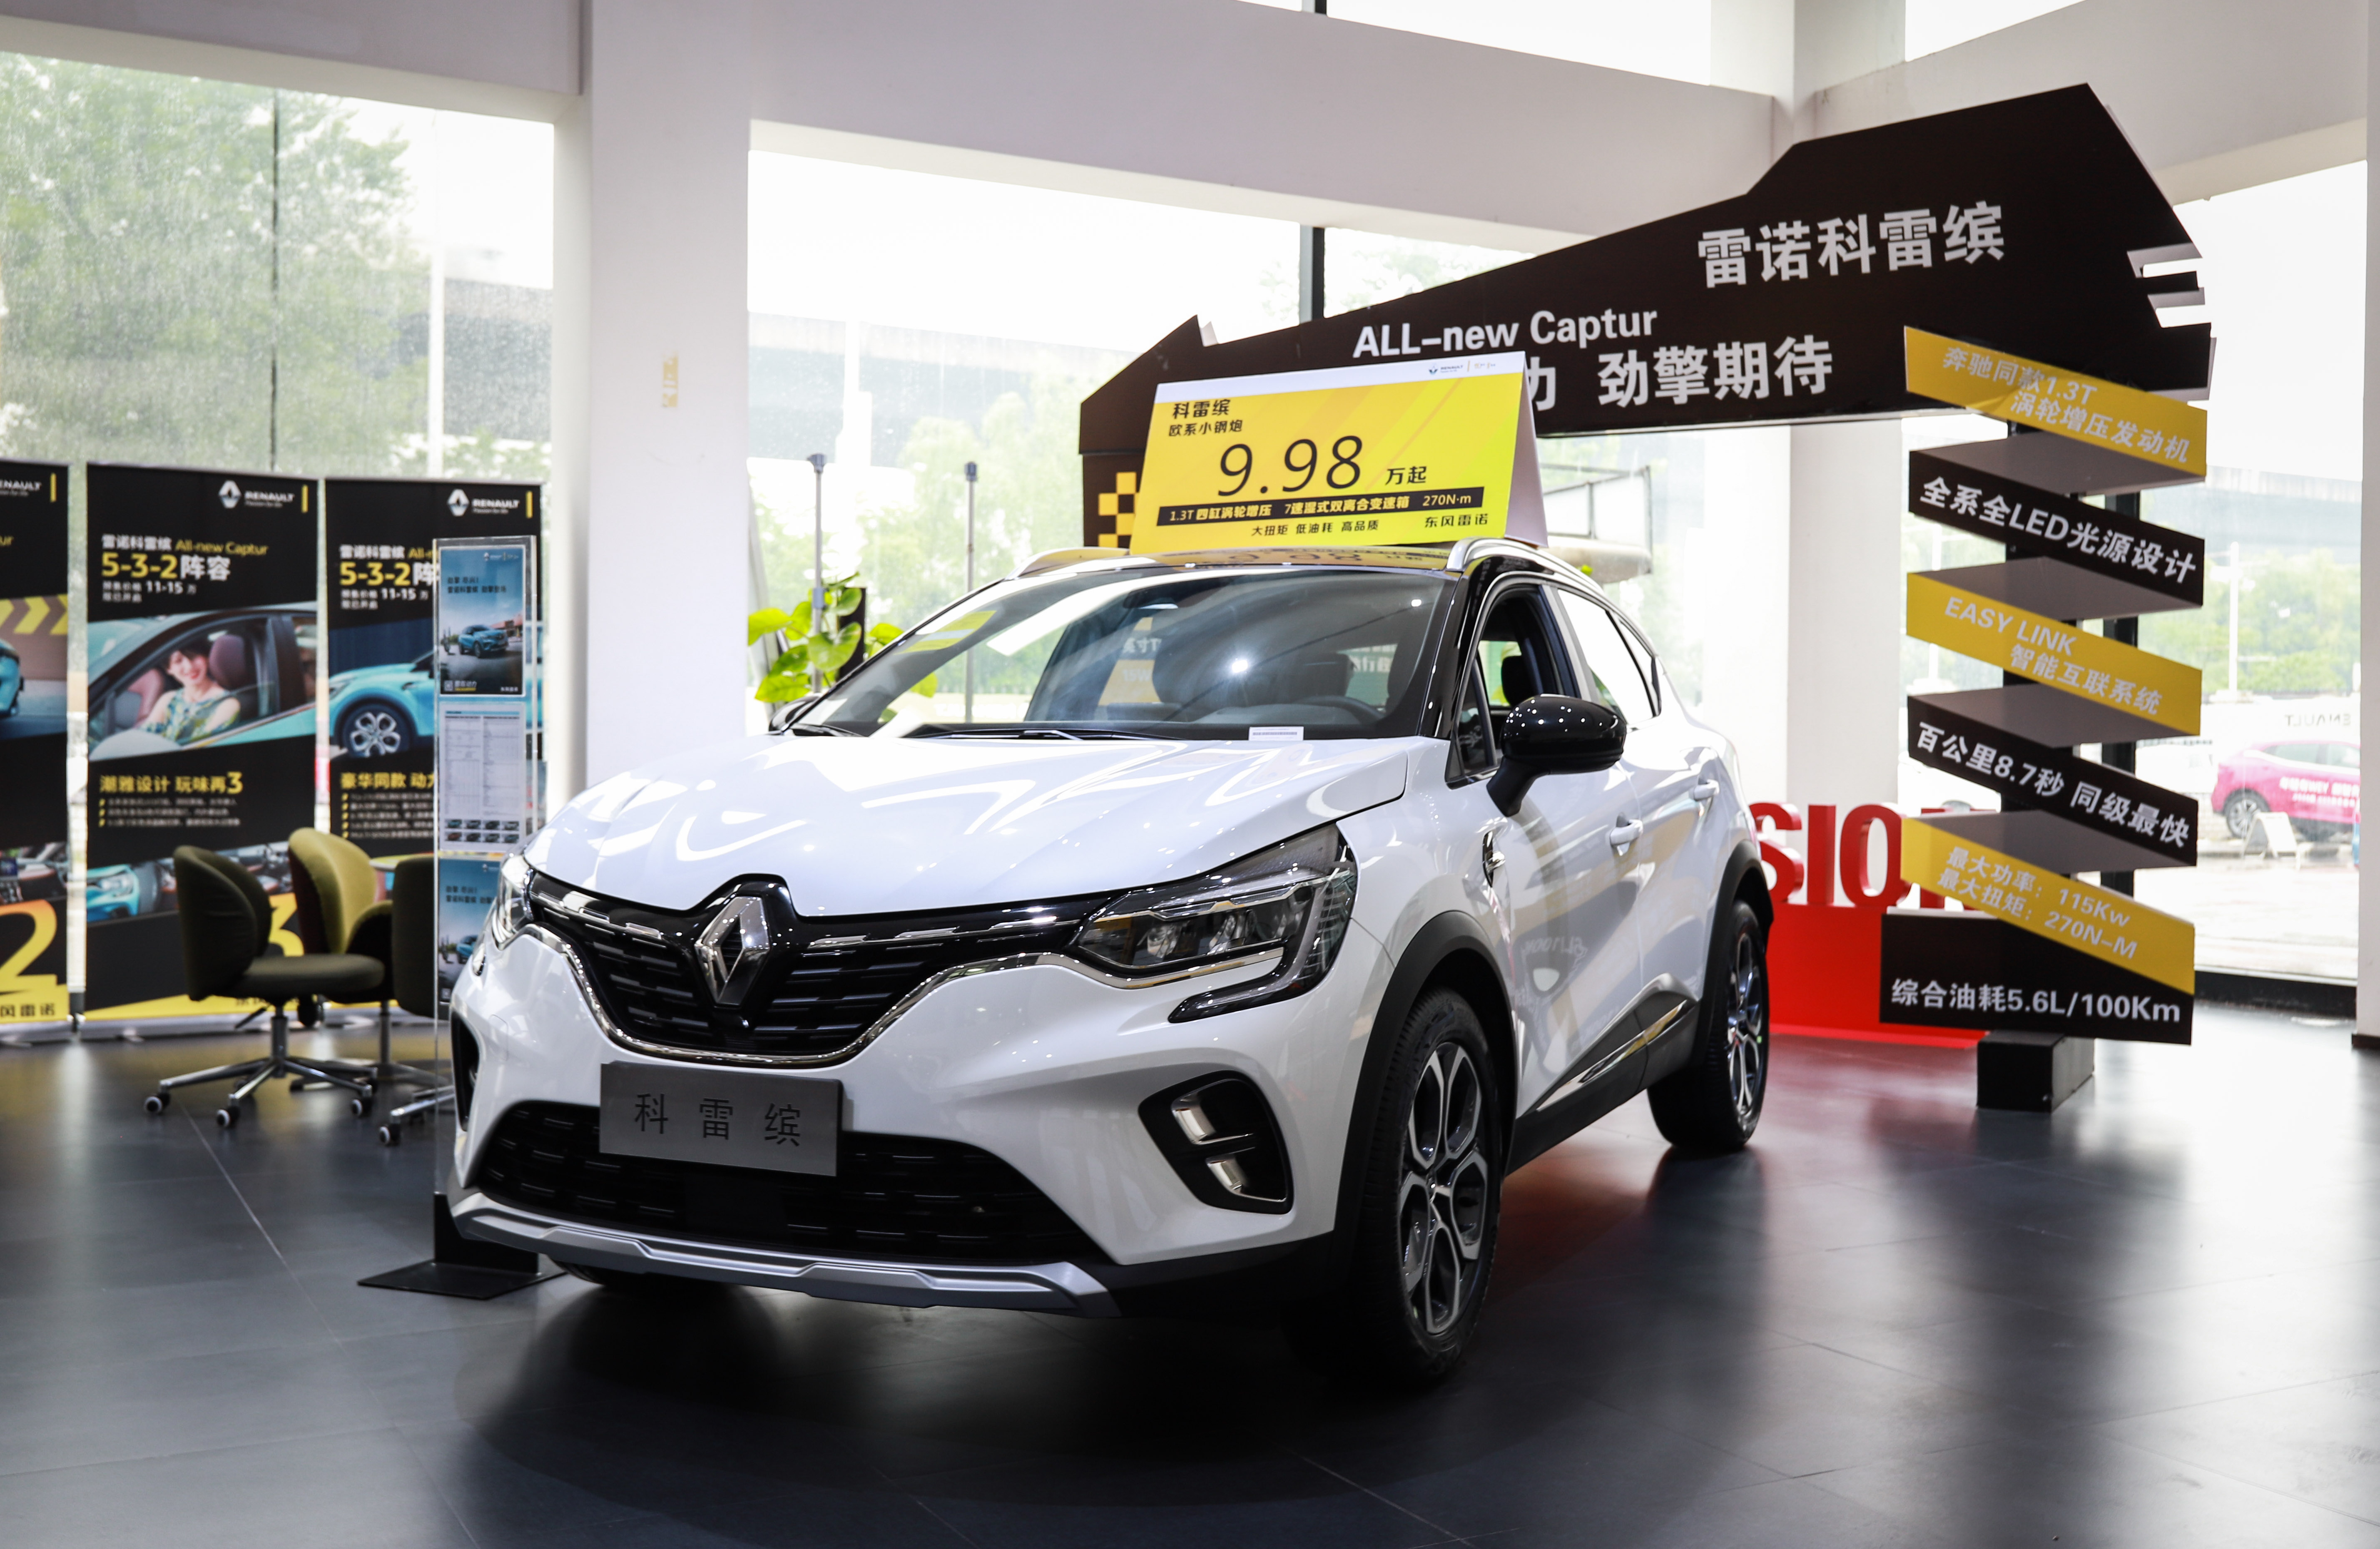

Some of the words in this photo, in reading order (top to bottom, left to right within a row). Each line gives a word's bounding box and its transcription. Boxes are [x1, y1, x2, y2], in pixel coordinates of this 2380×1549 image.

[1698, 201, 2004, 288] 雷诺科雷缤
[1353, 322, 1519, 358] ALL-new
[1530, 308, 1658, 348] Captur
[1598, 335, 1832, 408] 劲擎期待
[1943, 346, 2097, 405] 奔驰同款1.3T
[1169, 420, 1243, 437] 欧系小钢炮
[1173, 399, 1230, 420] 科雷缤
[2011, 390, 2191, 463] 涡轮增压发动机
[1218, 435, 1362, 496] 9.98
[1385, 466, 1427, 485] 万起
[473, 498, 520, 509] RENAULT
[1170, 510, 1194, 521] 1.3T
[1196, 504, 1272, 520] 四缸涡轮增压
[1285, 496, 1410, 515] 7速湿式双离合变速箱
[1251, 525, 1288, 536] 大扭矩
[1296, 522, 1333, 534] 低油耗
[1342, 520, 1379, 532] 高品质
[1425, 513, 1488, 528] 东风雷诺
[1919, 476, 2196, 584] 全系全LED光源设计
[102, 552, 231, 581] 5-3-2阵容
[381, 588, 416, 600] 11-15
[1944, 597, 2013, 632] EASY
[2017, 621, 2077, 656] LINK
[2010, 644, 2163, 715] 智能互联系统
[1917, 722, 2064, 797] 百公里8.7秒
[2070, 781, 2190, 848] 同级最快
[1891, 979, 2180, 1022] 综合油耗5.6L/100Km
[634, 1093, 800, 1147] 科雷缤
